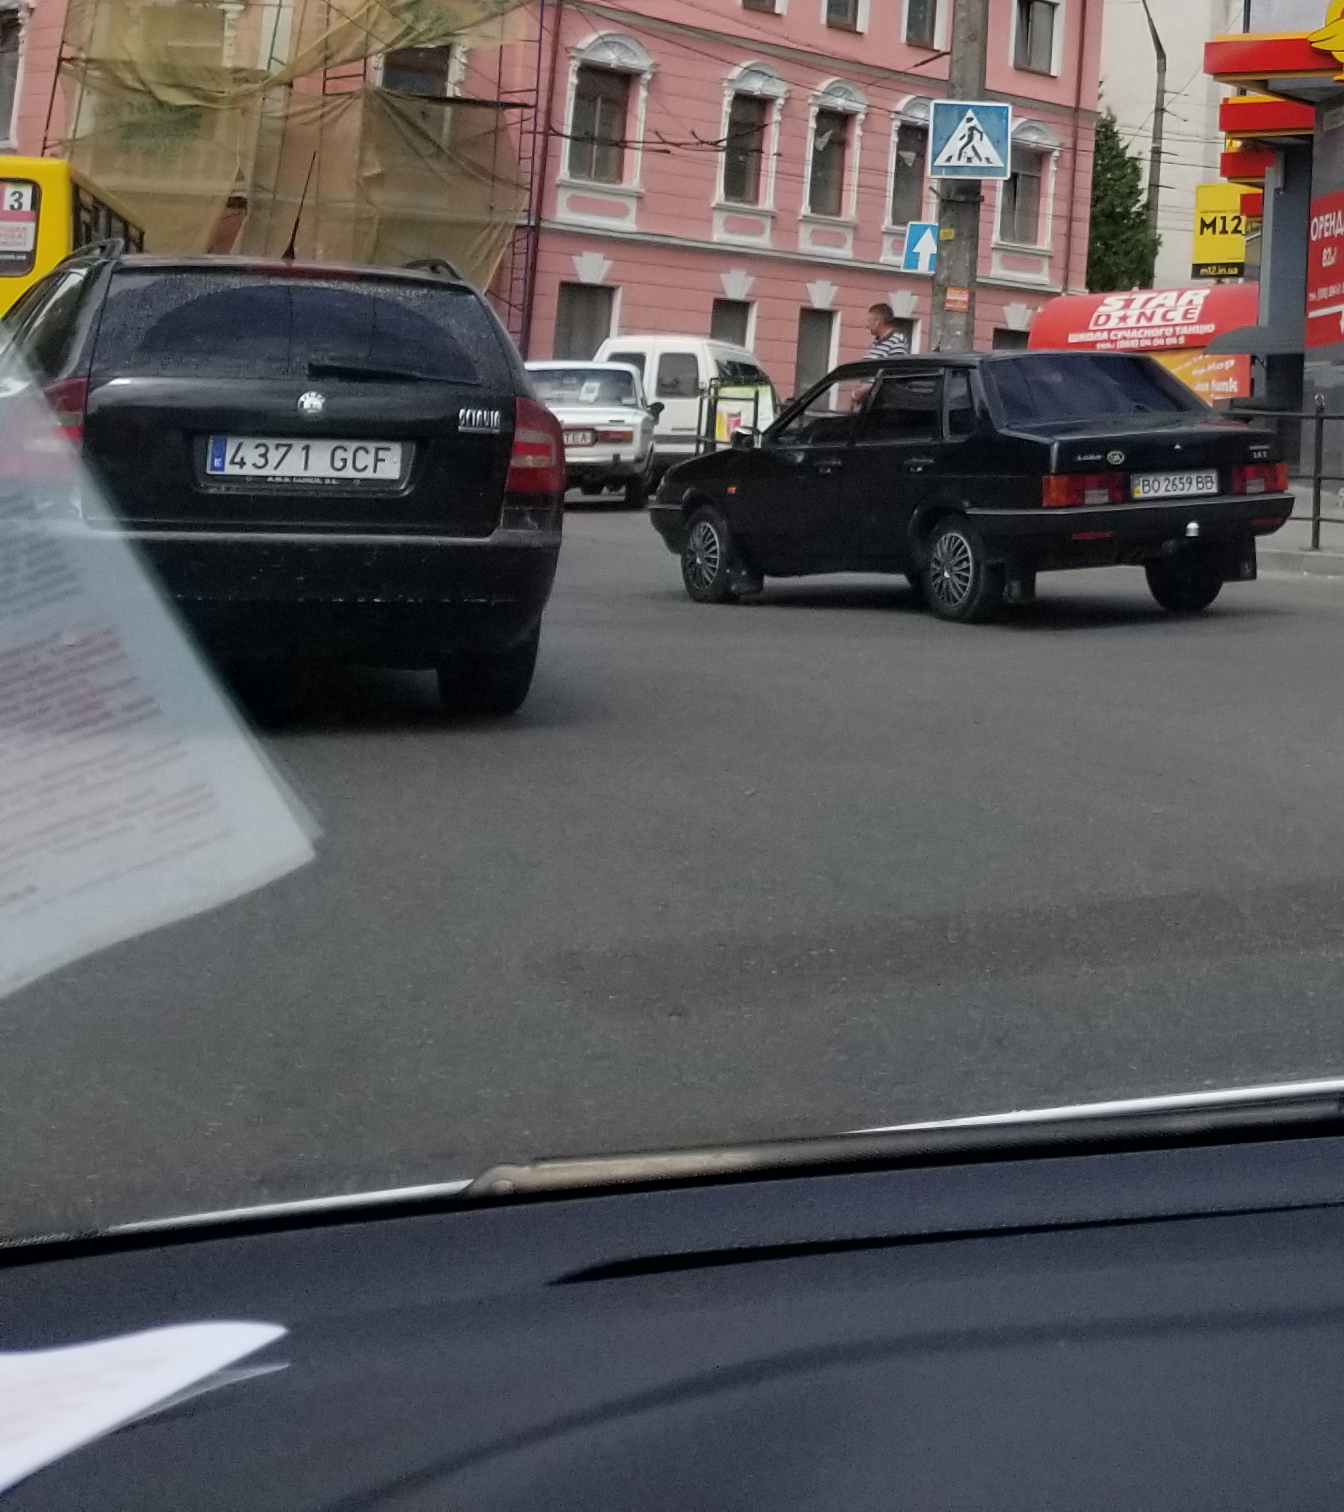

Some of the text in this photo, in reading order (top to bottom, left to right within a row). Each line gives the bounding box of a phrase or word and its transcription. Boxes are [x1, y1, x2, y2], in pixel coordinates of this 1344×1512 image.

[1199, 215, 1244, 235] M12
[1097, 288, 1211, 312] STAR
[1093, 307, 1200, 327] DNCE
[229, 442, 311, 472] 4371
[330, 445, 392, 474] GCF
[1141, 478, 1160, 494] BO
[1163, 476, 1193, 493] 2659
